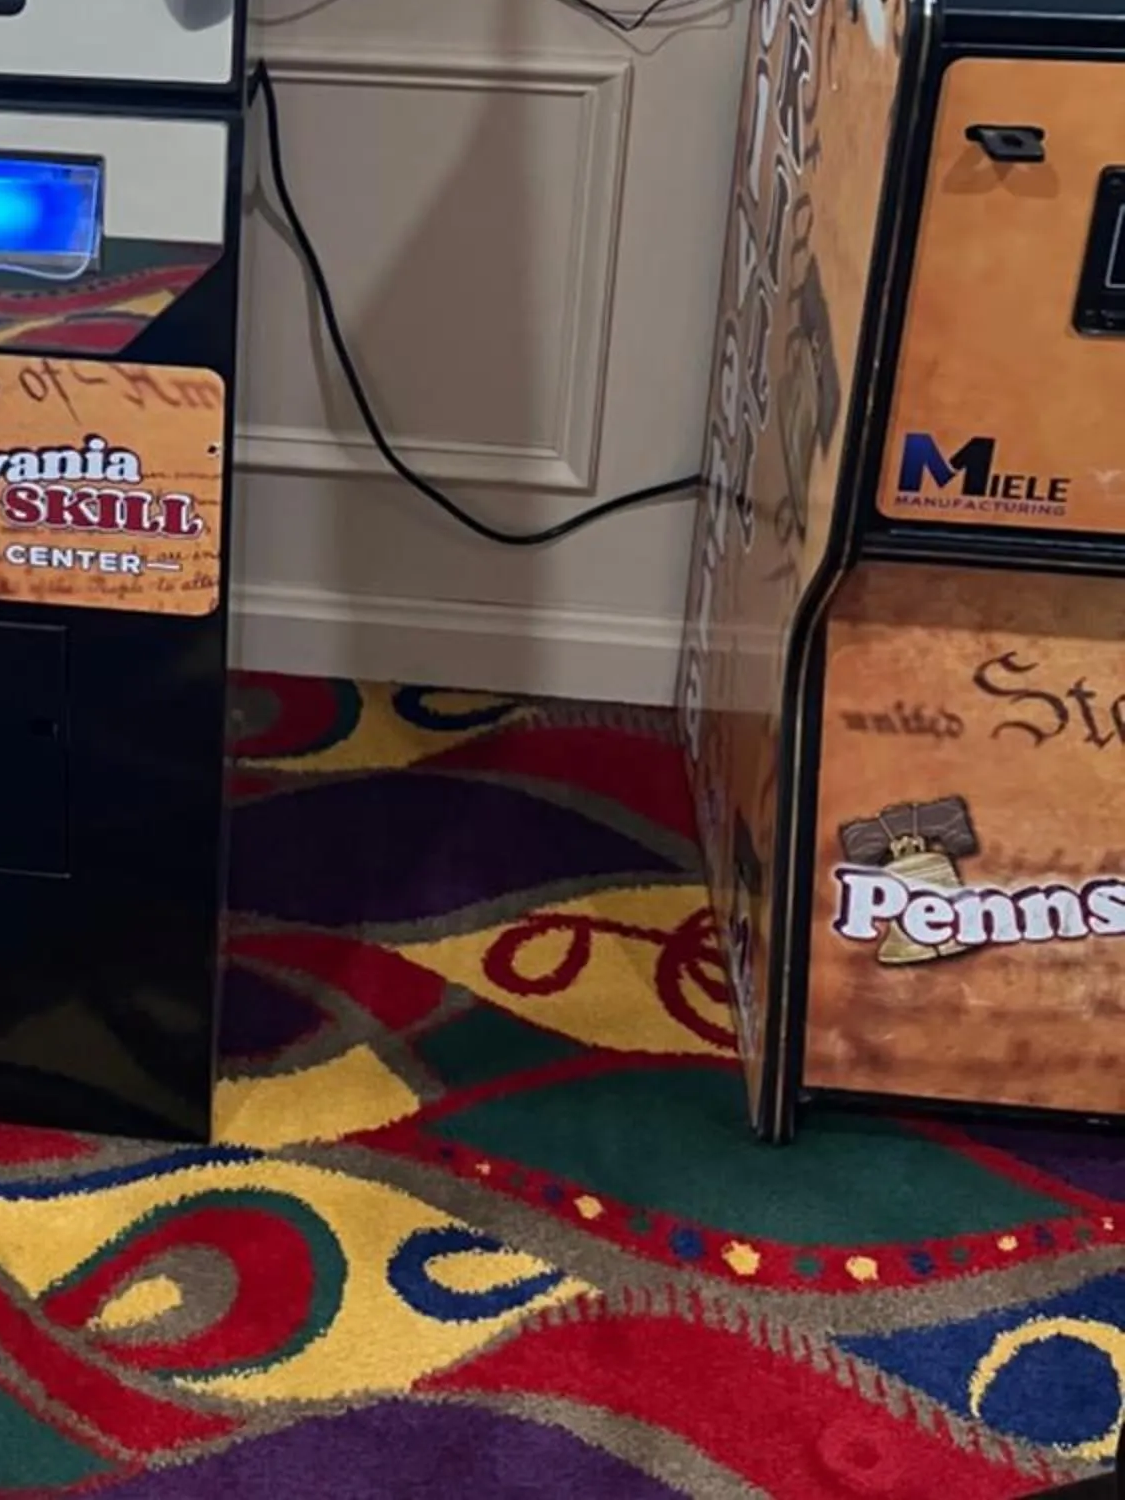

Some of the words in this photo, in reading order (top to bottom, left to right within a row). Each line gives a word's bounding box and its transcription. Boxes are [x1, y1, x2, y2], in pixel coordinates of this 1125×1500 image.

[898, 433, 1071, 502] MIELE
[2, 483, 205, 538] SKILL
[894, 495, 1067, 517] MANUFACTURING
[6, 545, 141, 574] CENTER
